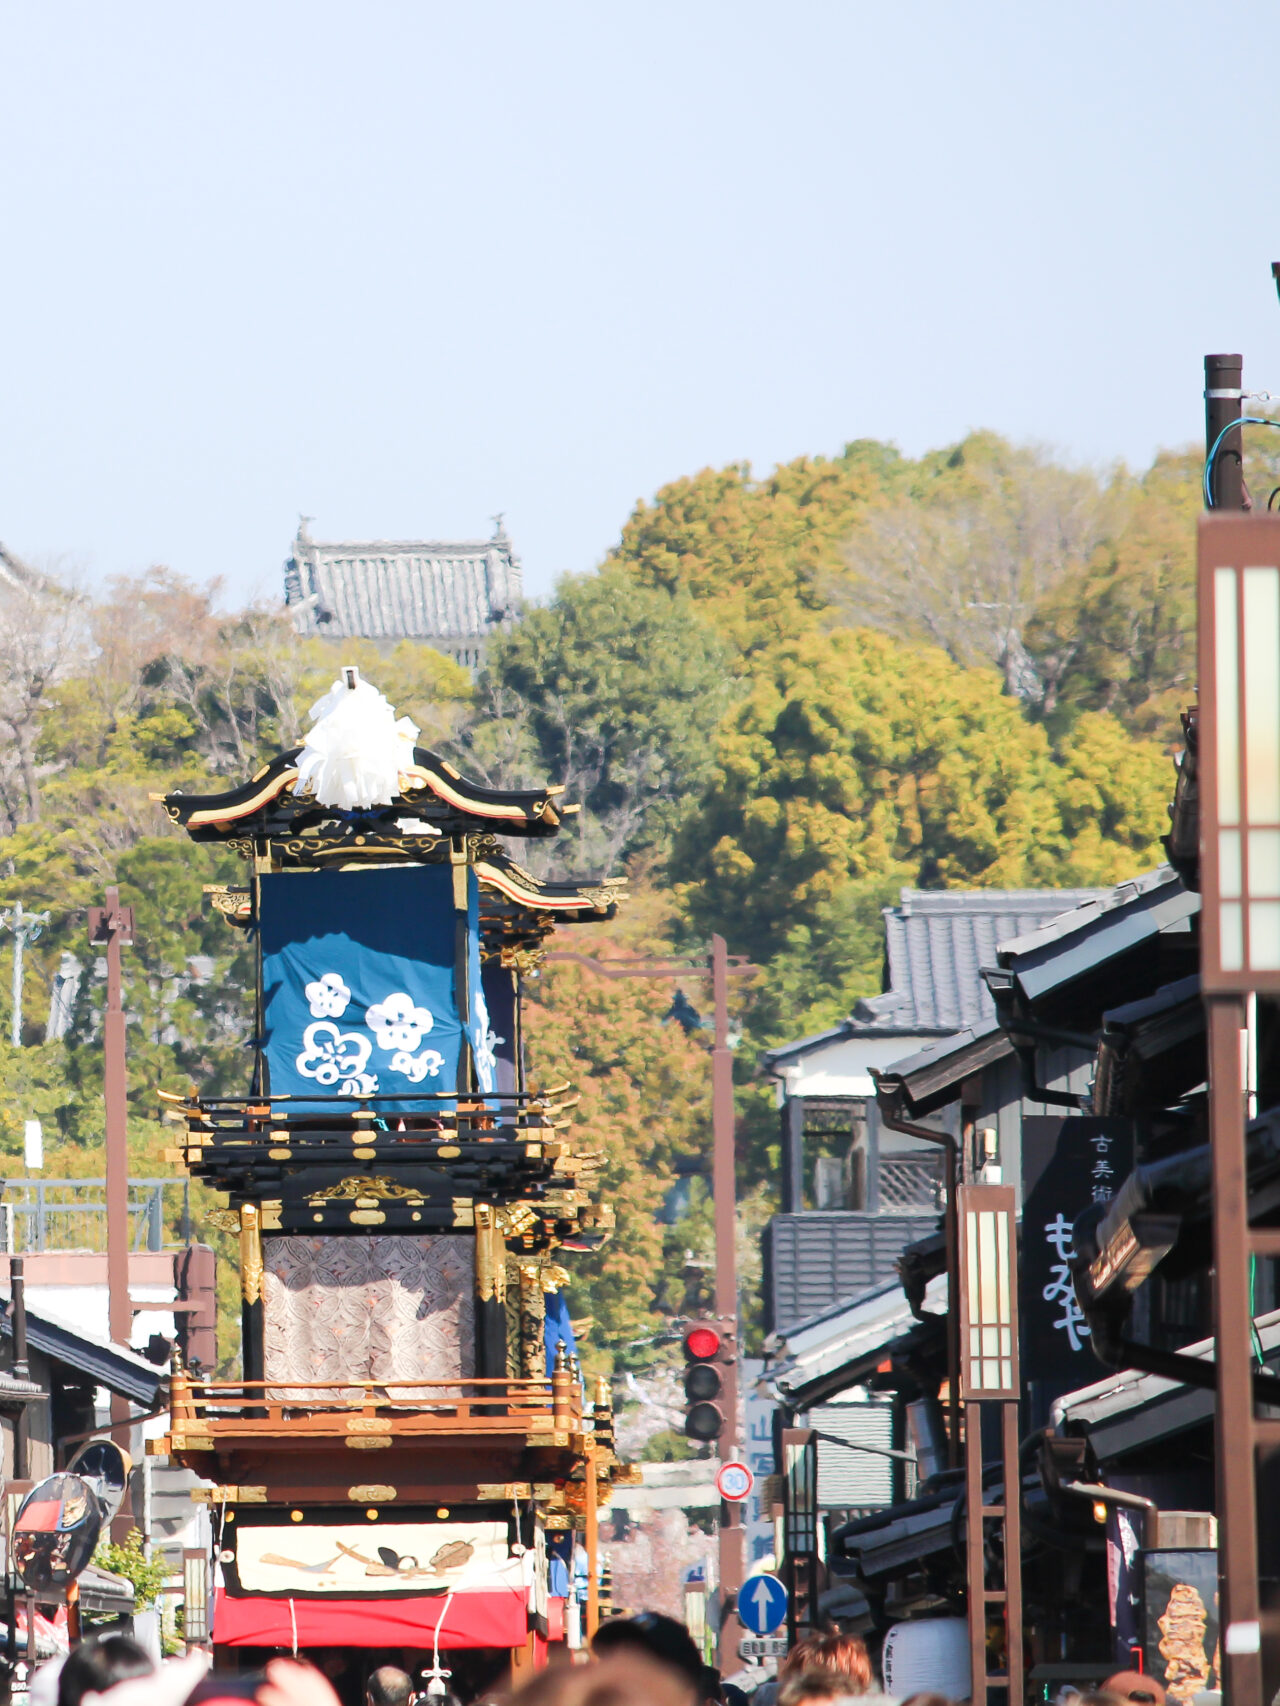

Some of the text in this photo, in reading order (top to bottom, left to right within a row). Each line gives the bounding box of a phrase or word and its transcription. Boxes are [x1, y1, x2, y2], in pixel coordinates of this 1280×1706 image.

[1088, 1133, 1115, 1203] 古美術
[724, 1473, 746, 1490] 30
